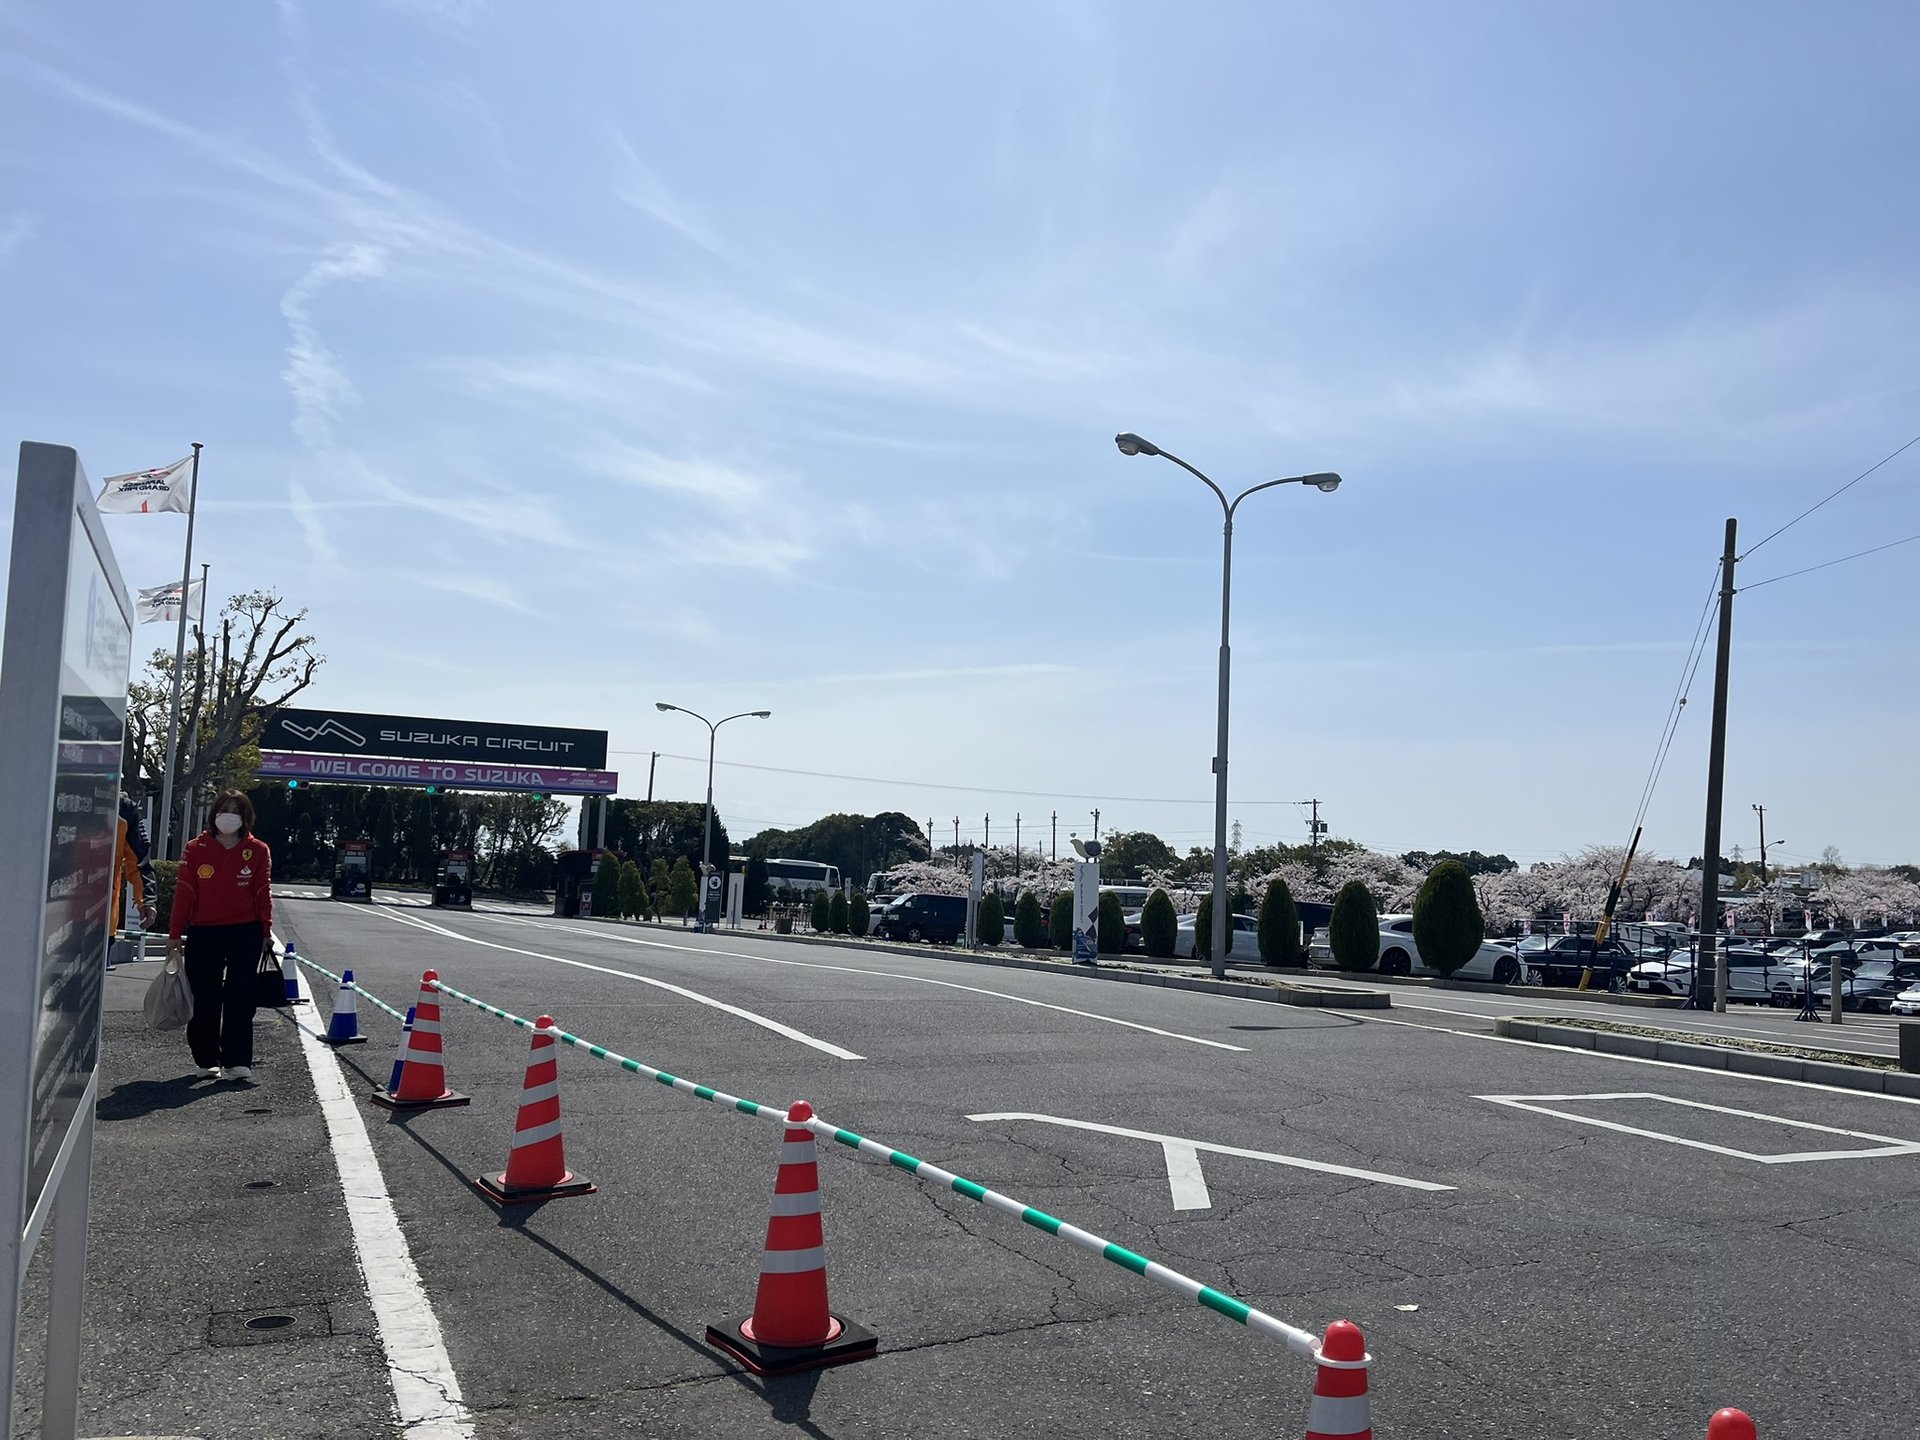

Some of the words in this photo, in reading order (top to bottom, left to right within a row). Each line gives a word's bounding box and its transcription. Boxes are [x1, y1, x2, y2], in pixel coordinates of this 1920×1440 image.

[379, 729, 479, 747] SUZUKA
[485, 736, 575, 753] CIRCUIT
[309, 758, 420, 779] WELCOME
[428, 765, 458, 781] TO
[464, 767, 545, 786] SUZUKA
